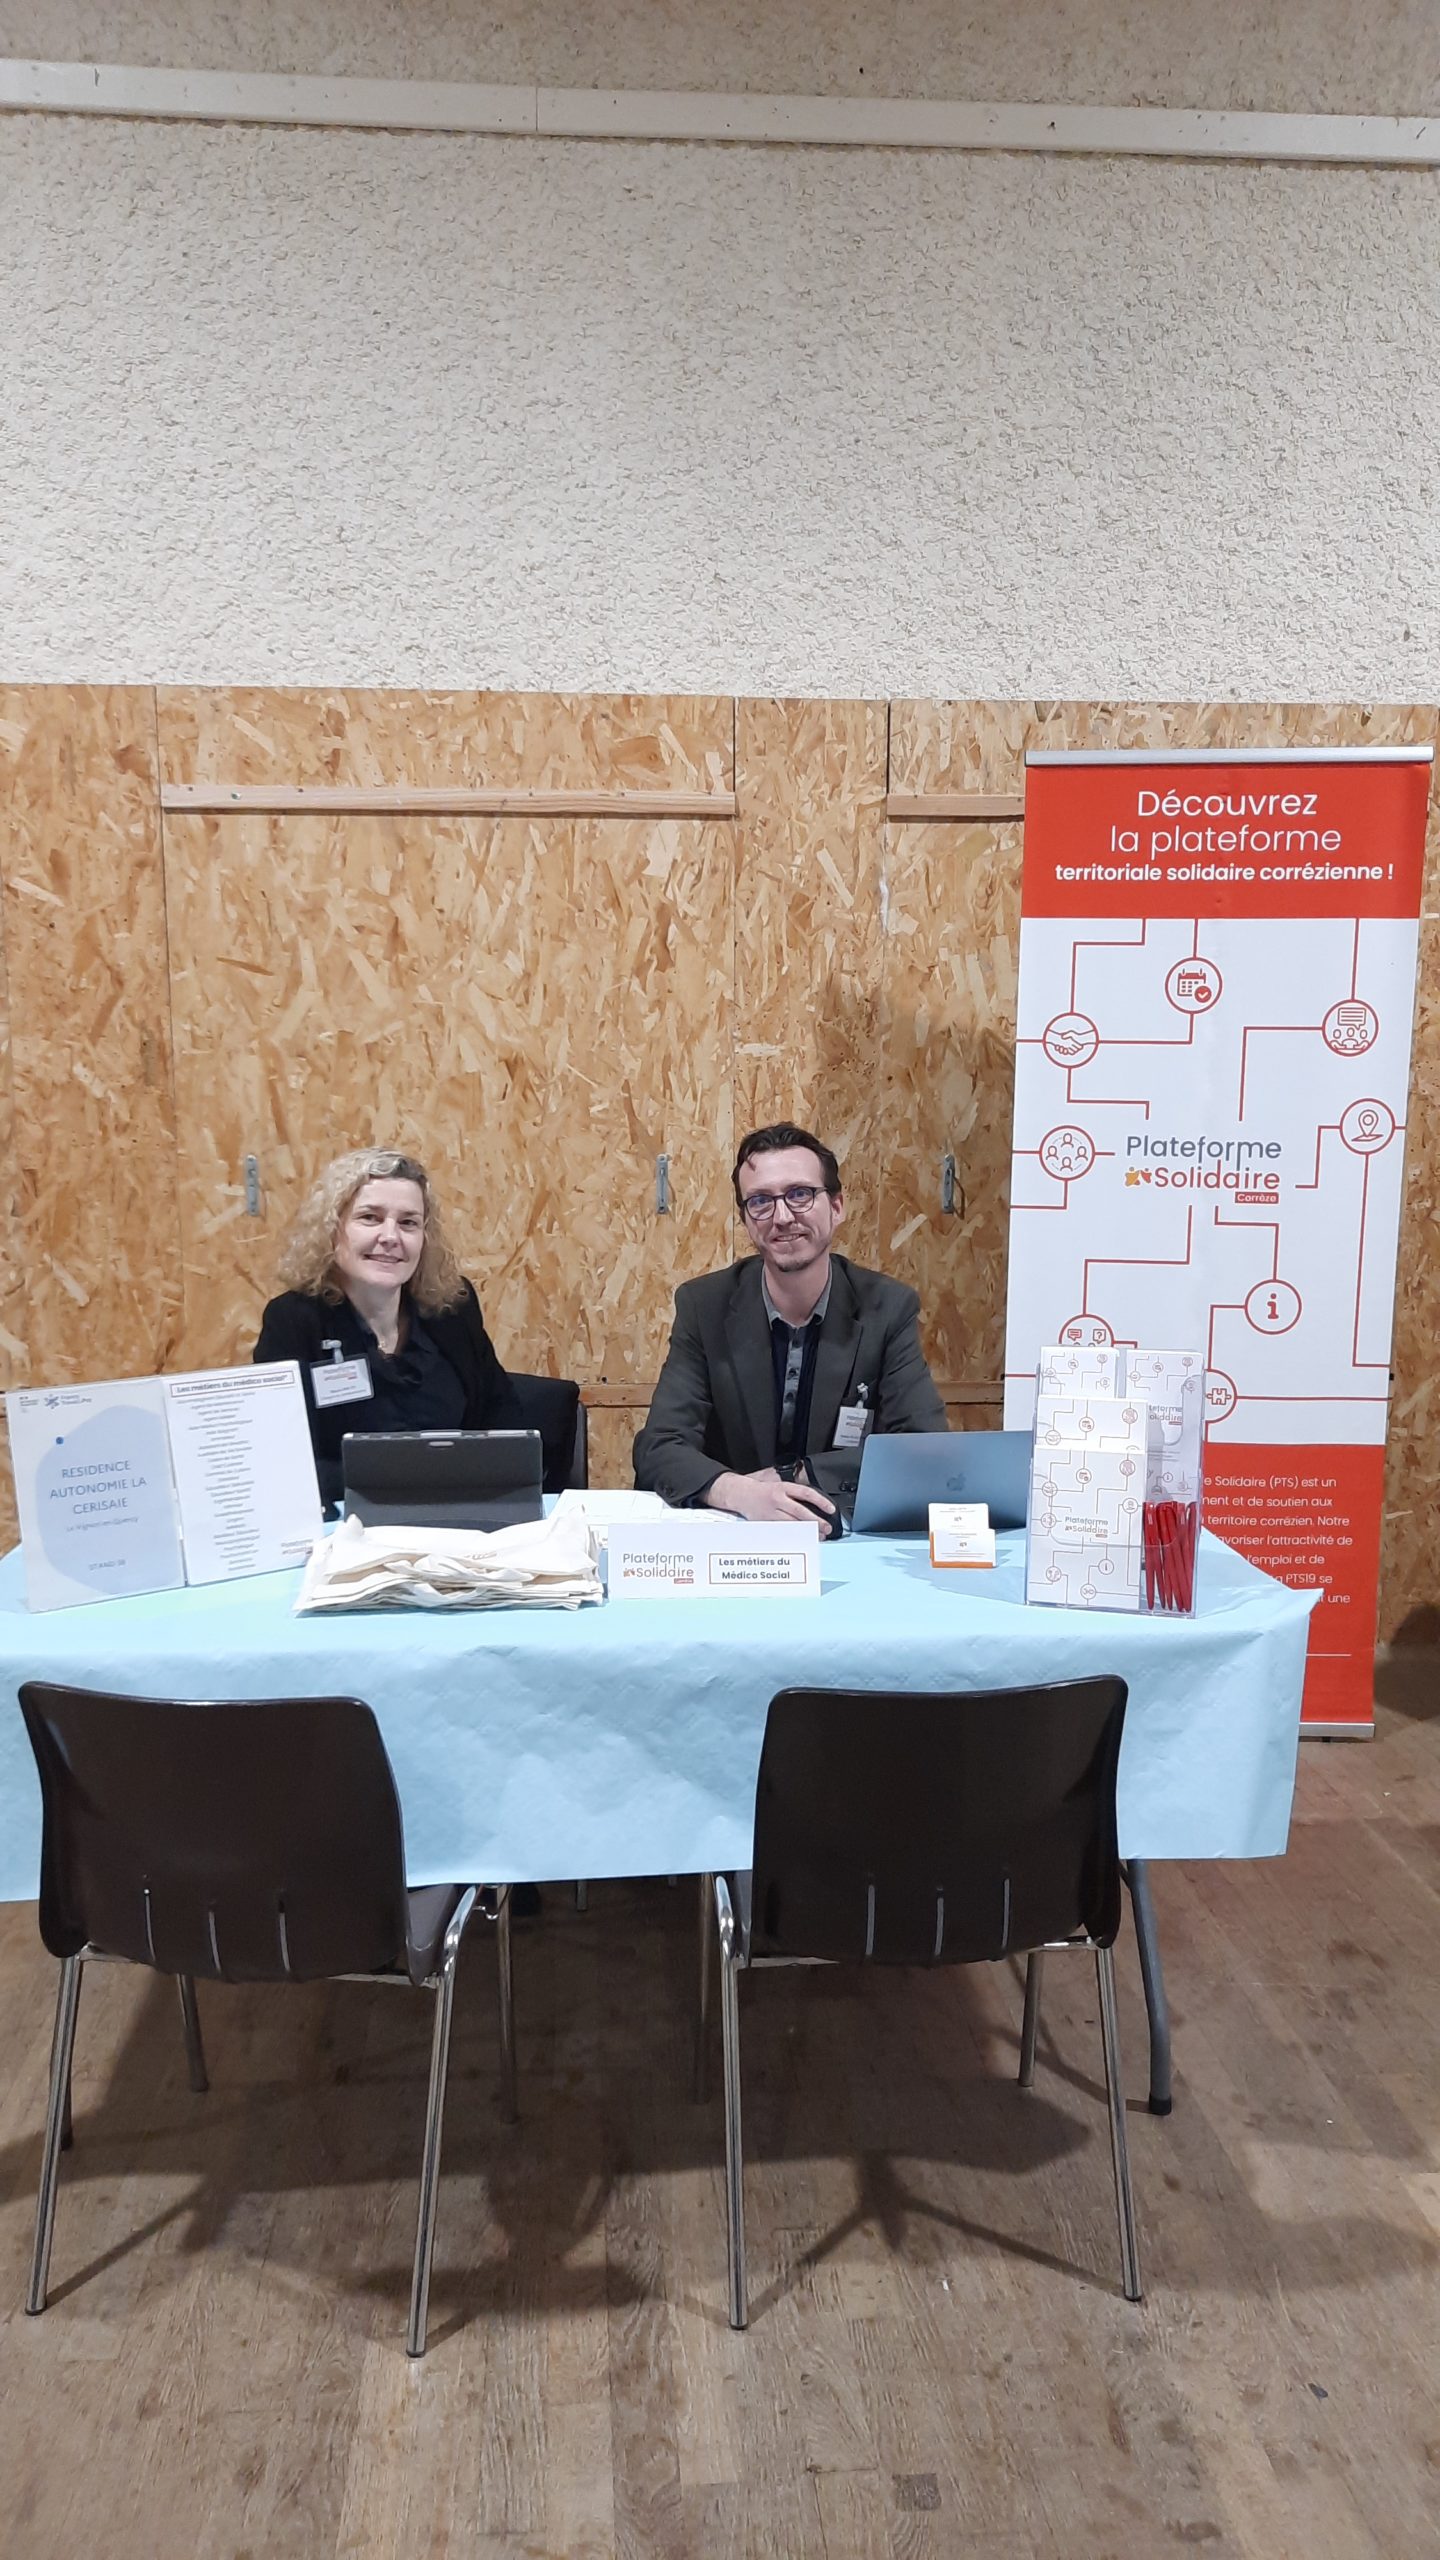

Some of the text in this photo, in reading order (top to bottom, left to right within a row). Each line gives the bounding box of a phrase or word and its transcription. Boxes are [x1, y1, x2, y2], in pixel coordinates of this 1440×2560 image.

[1137, 789, 1318, 817] Découvrez
[1109, 824, 1342, 860] la plateforme
[1055, 864, 1162, 881] territoriale
[1166, 863, 1255, 881] solidaire
[1259, 863, 1383, 881] corrézienne
[1126, 1135, 1282, 1171] Plateforme
[1154, 1160, 1281, 1190] Solidaire
[61, 1460, 131, 1478] RESIDENCE
[50, 1477, 147, 1499] AUTONOMIE LA
[1215, 1476, 1266, 1488] Solidaire
[1269, 1475, 1298, 1489] (PTS)
[1301, 1478, 1318, 1488] est
[1321, 1479, 1337, 1488] un
[73, 1497, 129, 1514] CERISAIE
[1232, 1496, 1244, 1506] et
[1247, 1496, 1264, 1507] de
[1266, 1496, 1308, 1507] soutien
[1310, 1498, 1333, 1507] aux
[1065, 1516, 1109, 1527] Plateforme
[1207, 1515, 1257, 1526] territoire
[1317, 1516, 1350, 1526] Notre
[1072, 1525, 1109, 1534] Solidaire
[1266, 1535, 1334, 1546] l'attractivité
[1336, 1535, 1353, 1546] de
[622, 1553, 694, 1569] Plateforme
[719, 1557, 791, 1567] Les métiers du
[1247, 1554, 1325, 1567] l'emploi et de
[636, 1563, 695, 1578] Solidaire
[721, 1570, 791, 1580] Médico Social
[1285, 1574, 1316, 1584] PTS19
[1319, 1575, 1333, 1584] se
[1327, 1594, 1351, 1604] une
